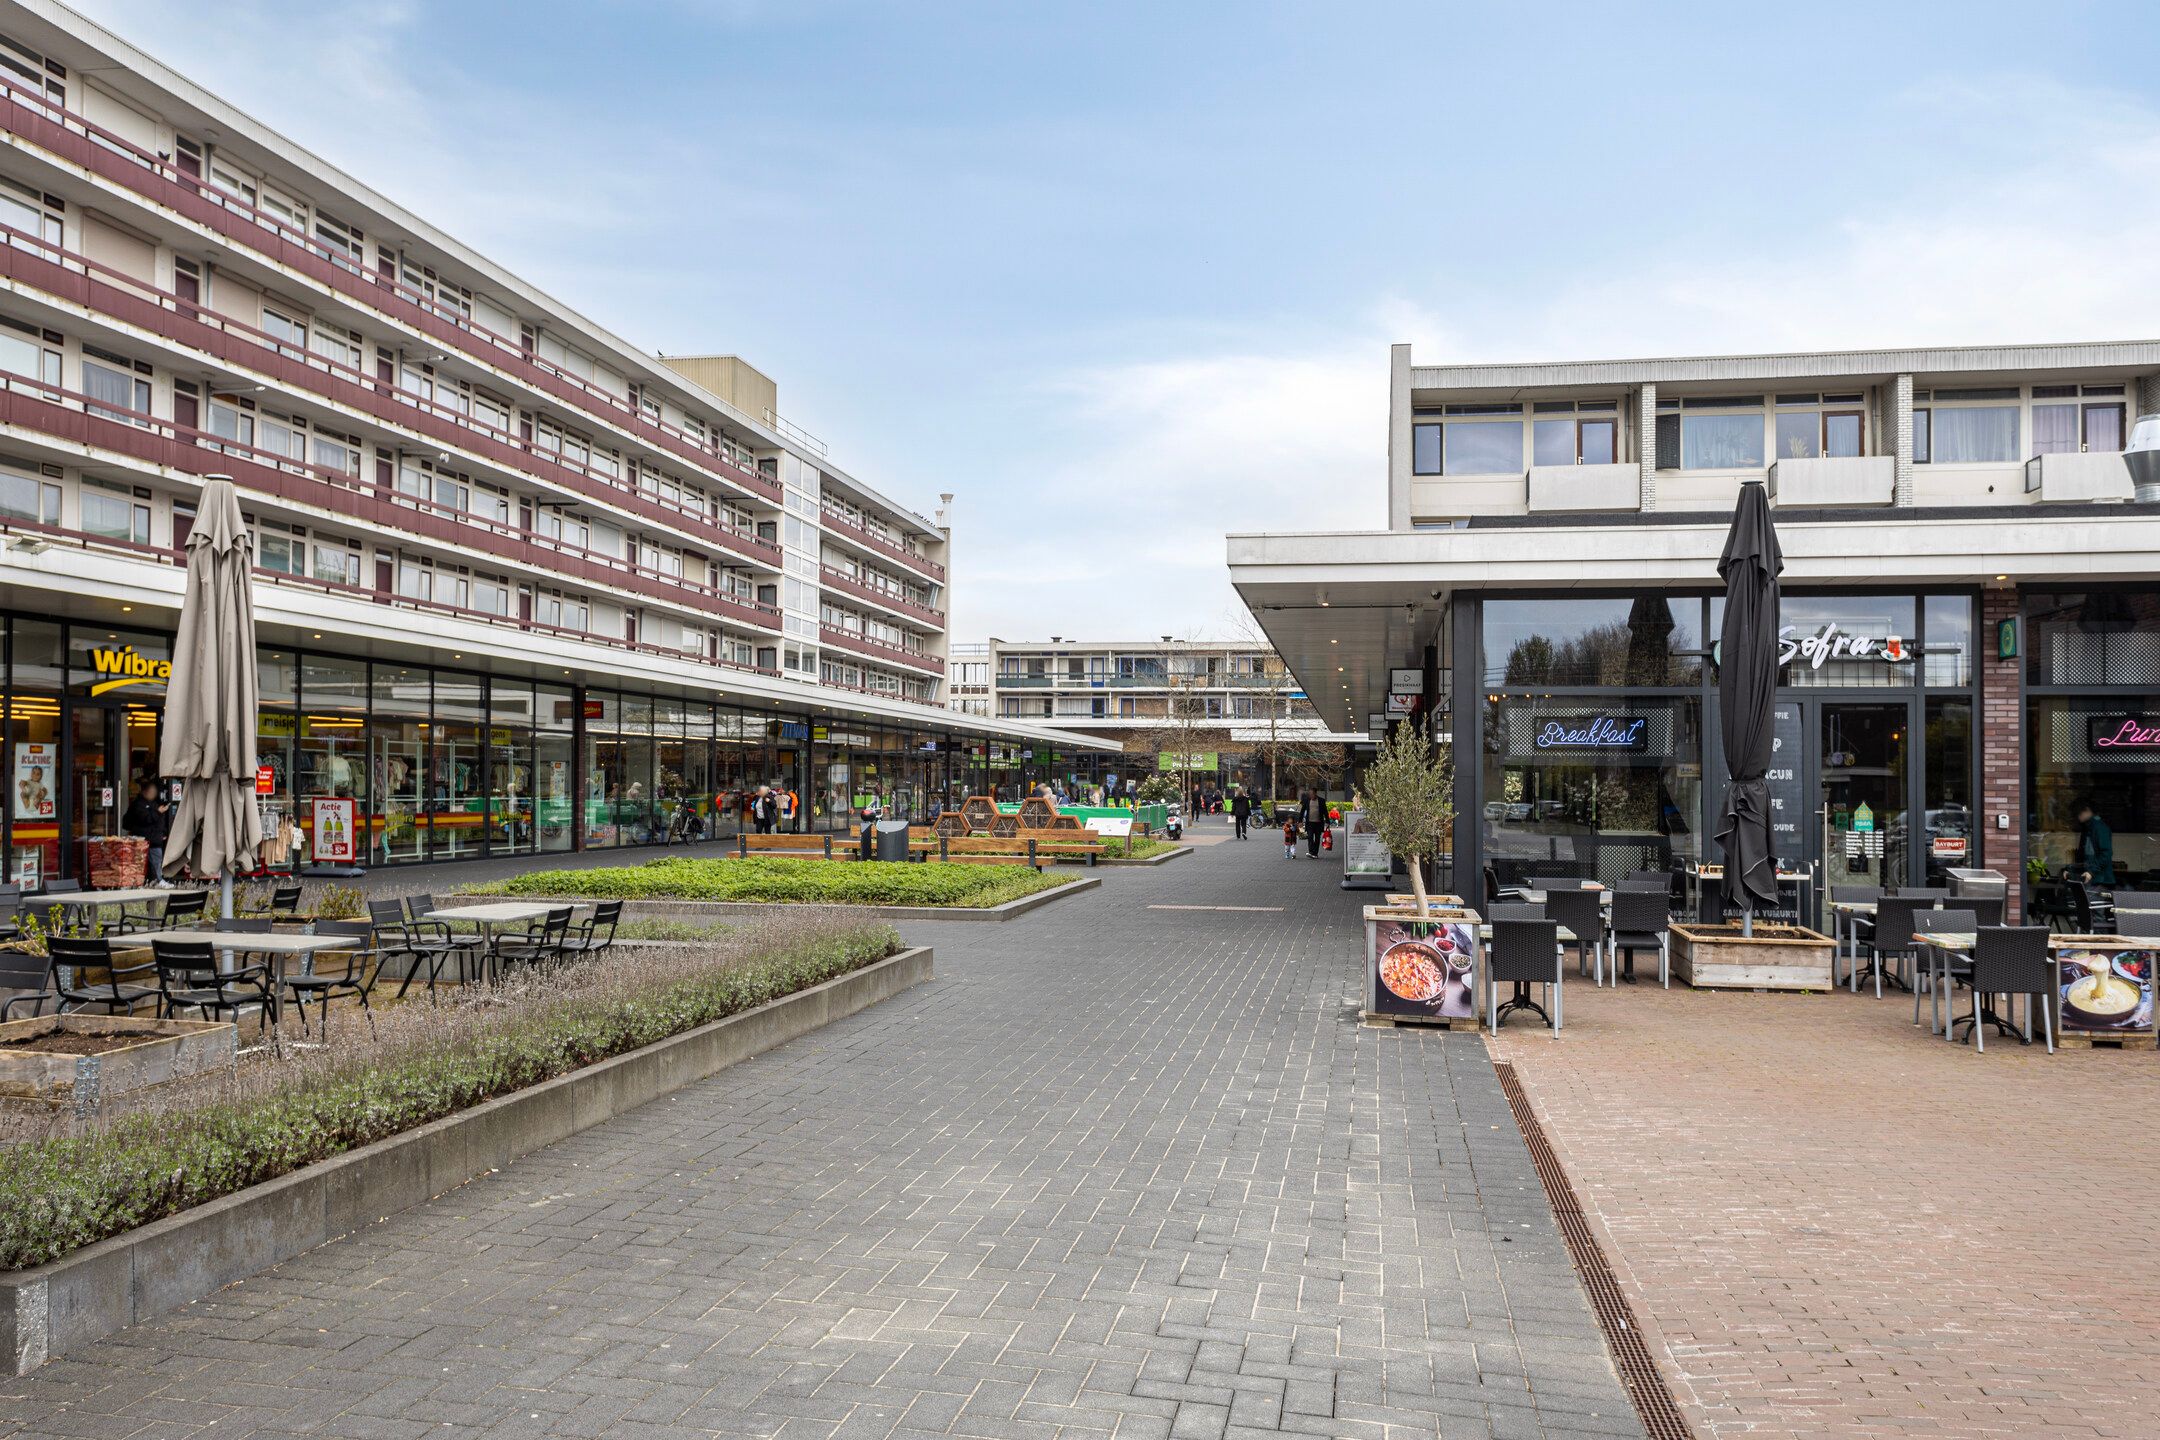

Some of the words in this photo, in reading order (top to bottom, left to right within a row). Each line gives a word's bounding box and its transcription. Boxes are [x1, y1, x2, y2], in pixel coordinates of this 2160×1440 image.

[92, 644, 172, 679] Wibra
[1779, 622, 1874, 670] Sofra
[1537, 717, 1644, 747] Breakfast
[320, 802, 342, 811] Actie
